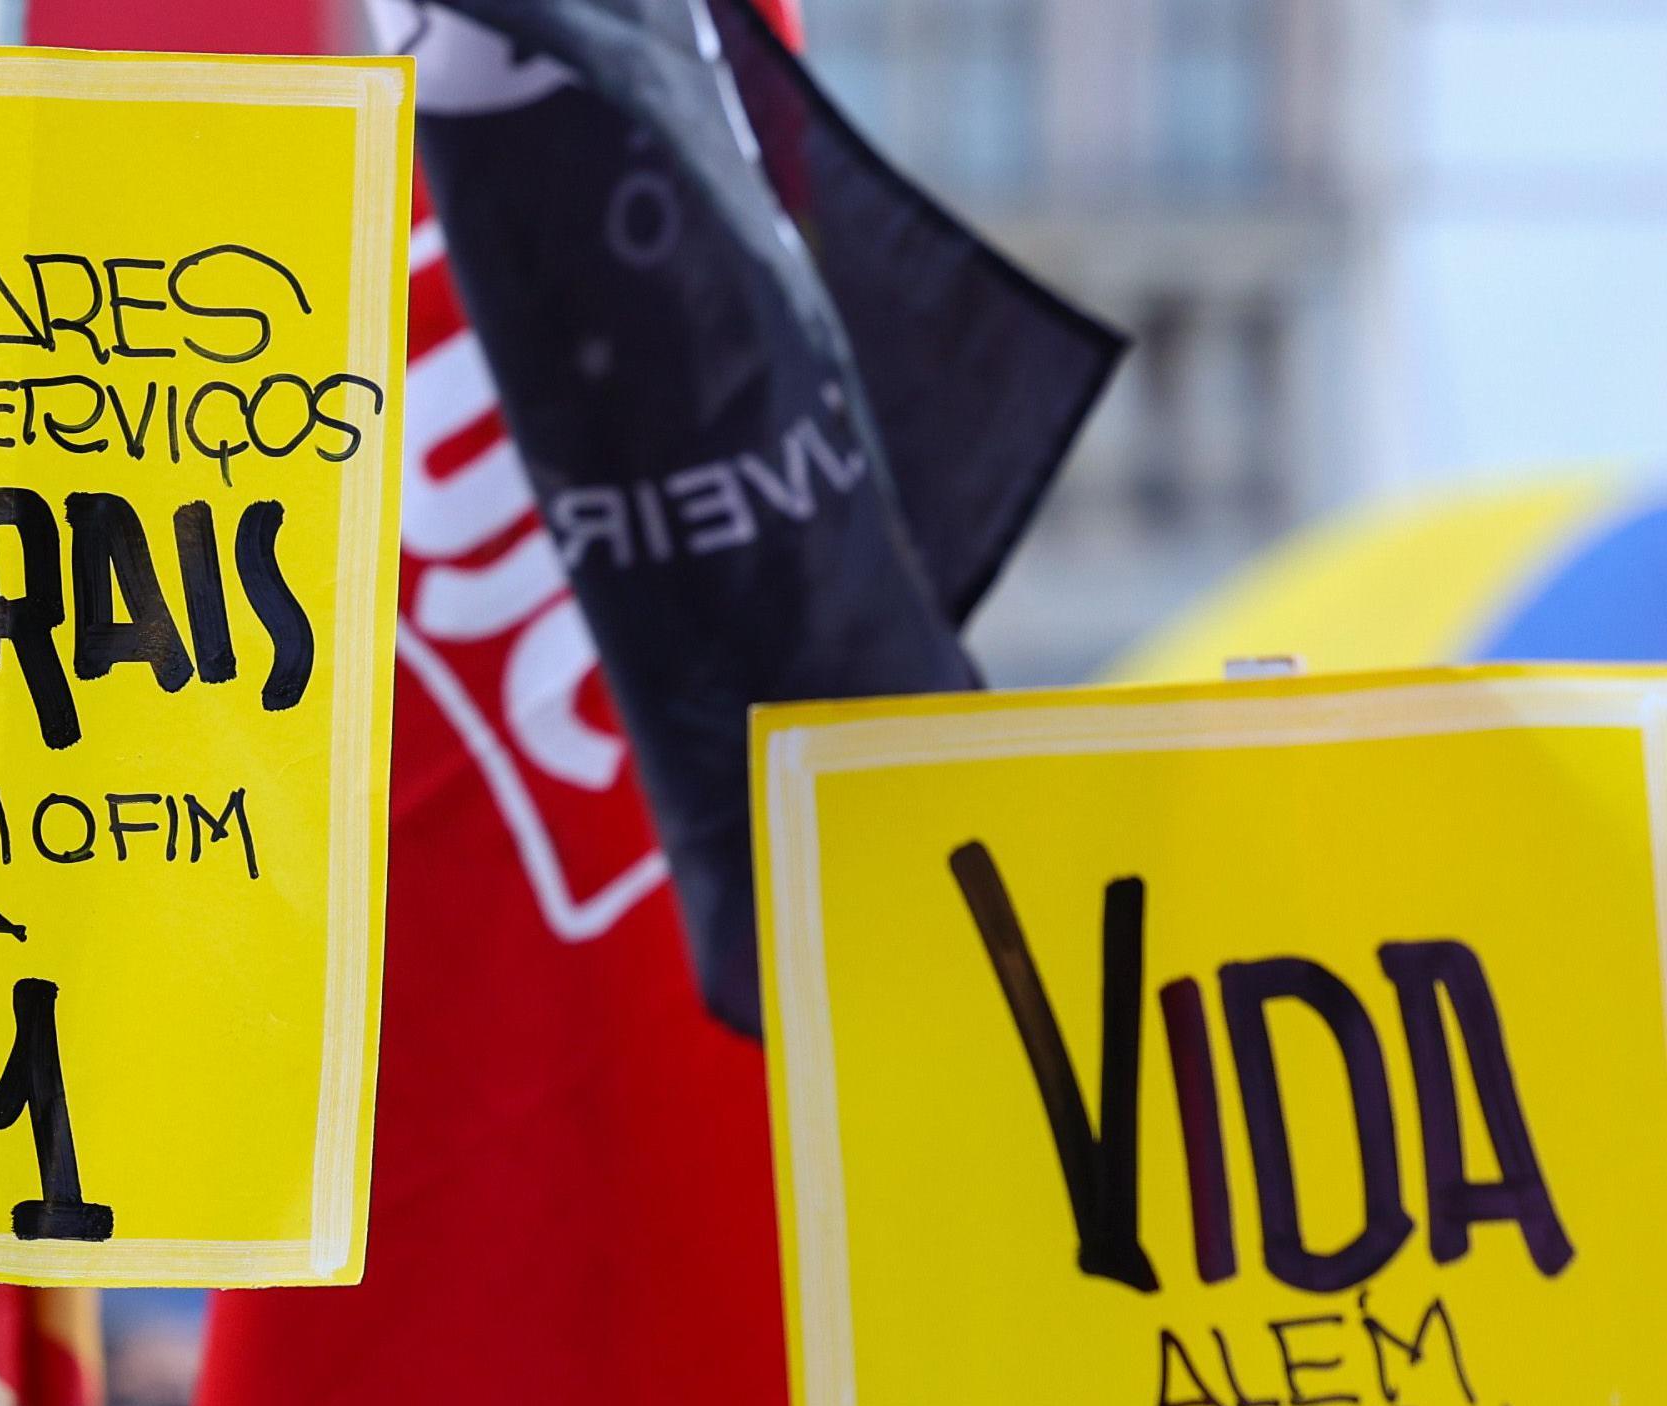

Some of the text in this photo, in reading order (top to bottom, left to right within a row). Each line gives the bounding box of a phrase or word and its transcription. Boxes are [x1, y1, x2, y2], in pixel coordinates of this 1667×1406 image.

[32, 793, 96, 863] O
[108, 787, 260, 879] FIM
[948, 839, 1576, 1293] VIDA
